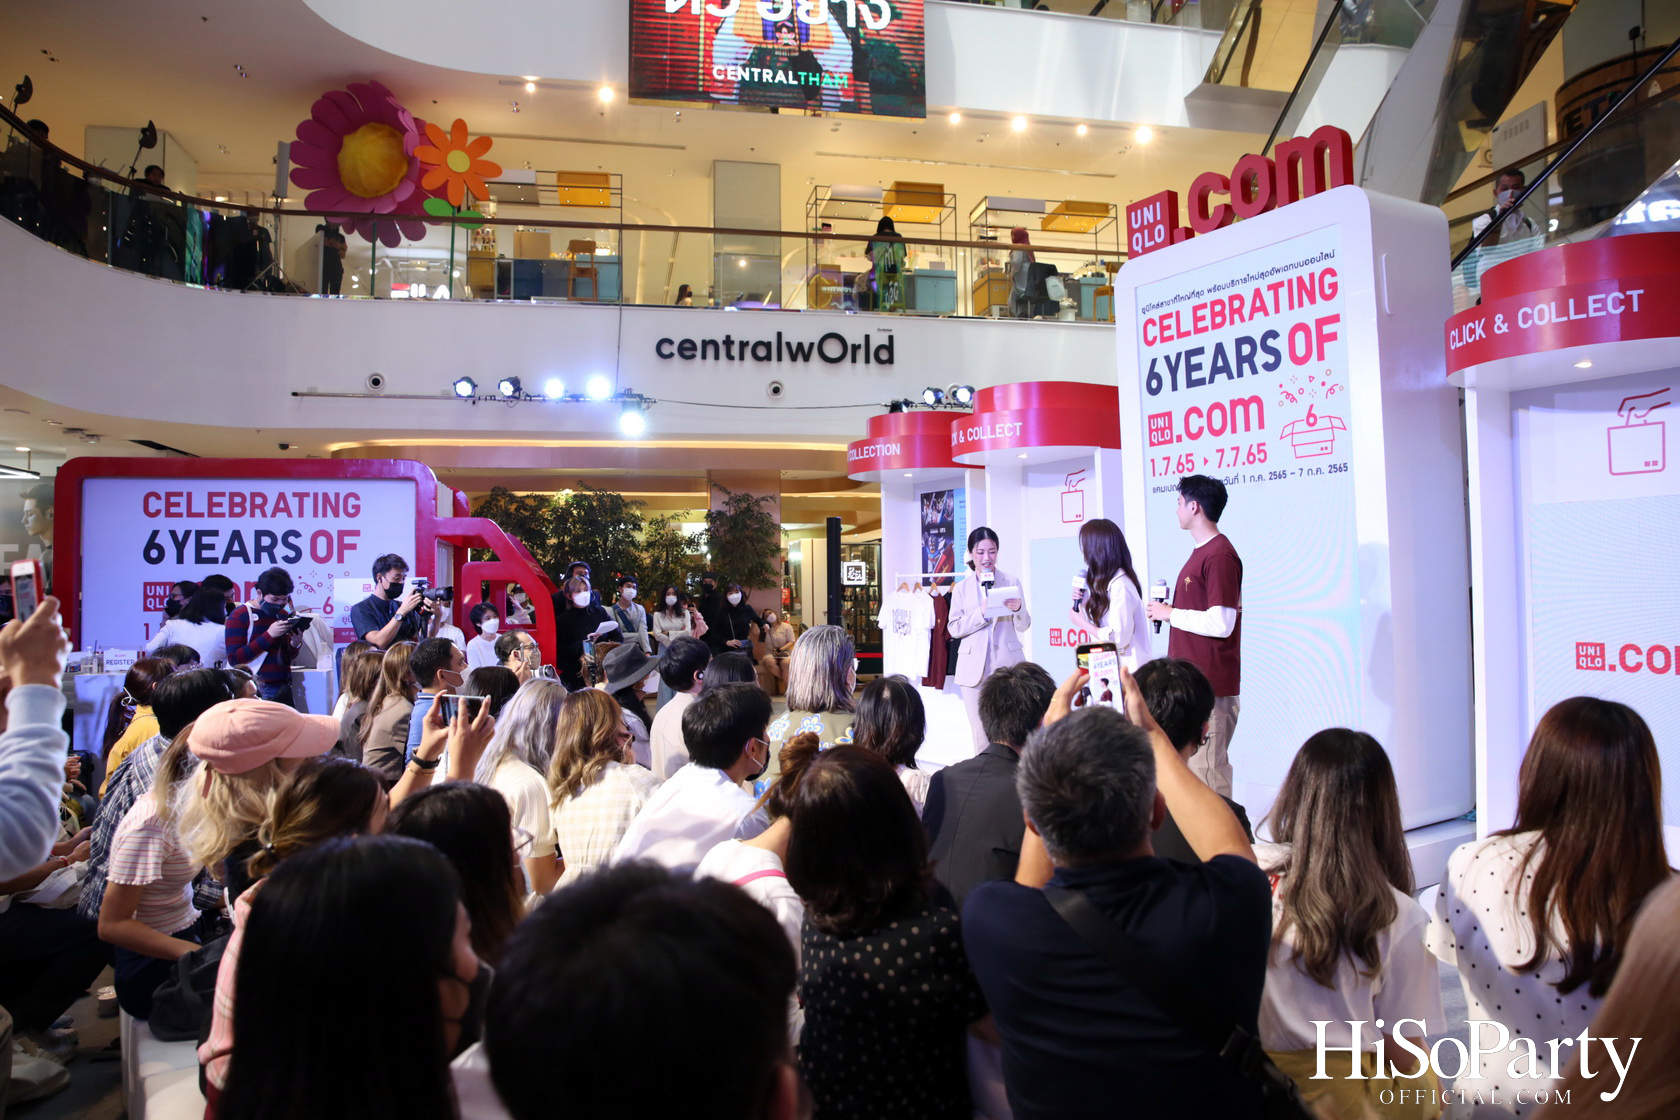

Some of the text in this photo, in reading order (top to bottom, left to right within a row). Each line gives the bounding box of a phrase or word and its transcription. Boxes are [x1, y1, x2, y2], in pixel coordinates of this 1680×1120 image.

[711, 66, 849, 88] CENTRALTHAM
[1173, 124, 1354, 245] .com
[1131, 201, 1161, 229] UNI
[1132, 224, 1165, 253] QLO
[1143, 267, 1339, 347] CELEBRATING
[1450, 289, 1645, 350] CLICK & COLLECT
[655, 331, 894, 365] centralwOrld
[1288, 313, 1341, 366] OF
[1150, 414, 1169, 429] UNI
[1176, 395, 1265, 443] .com
[1305, 404, 1318, 427] 6
[967, 422, 1023, 441] COLLECT
[1151, 431, 1171, 444] QLO
[1150, 442, 1268, 477] 1.7.65 7.7.65
[1268, 470, 1288, 480] 2565
[1299, 468, 1304, 477] 7
[1327, 463, 1349, 474] 2565
[143, 491, 361, 518] CELEBRATING
[310, 529, 361, 564] OF
[146, 585, 169, 596] UNI
[323, 596, 334, 615] 6
[1578, 646, 1600, 656] UNI
[1579, 657, 1602, 668] QLO
